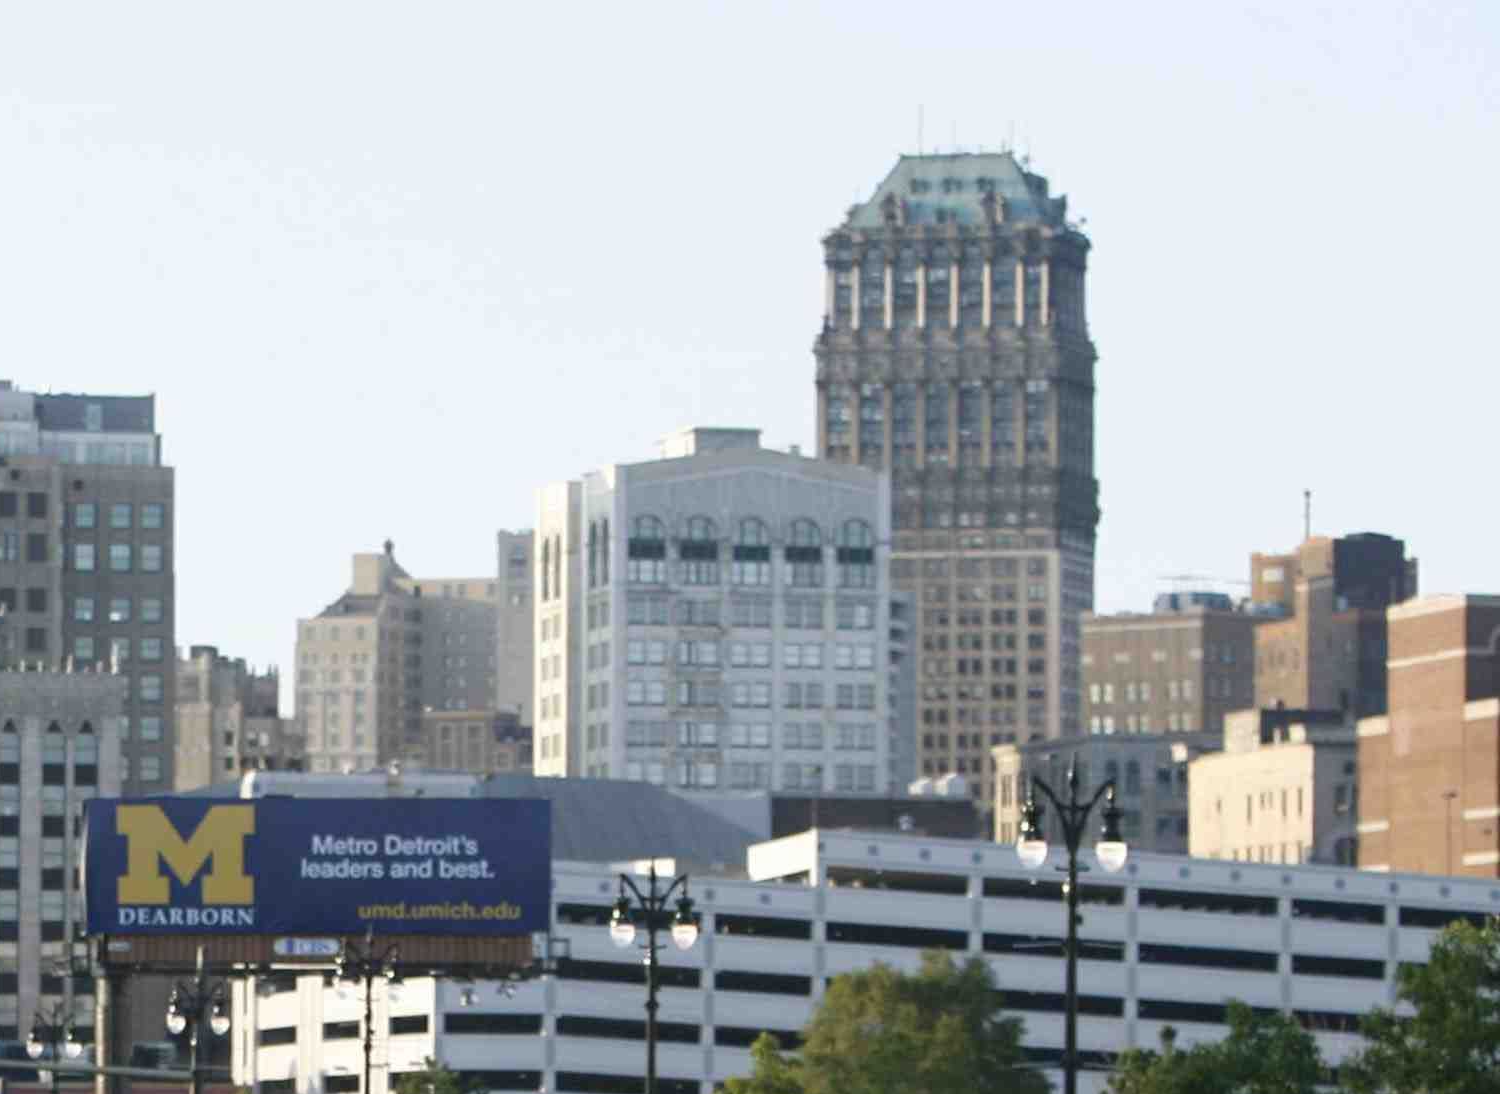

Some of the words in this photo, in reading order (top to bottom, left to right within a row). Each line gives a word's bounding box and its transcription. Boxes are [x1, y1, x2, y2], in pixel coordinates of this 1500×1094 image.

[116, 805, 255, 904] M
[312, 834, 377, 856] Metro
[384, 834, 478, 856] Detroit's
[301, 860, 383, 879] leaders
[390, 860, 431, 879] and
[438, 860, 495, 879] best.
[118, 908, 254, 925] DEARBORN
[358, 901, 521, 921] umd.umich.edu
